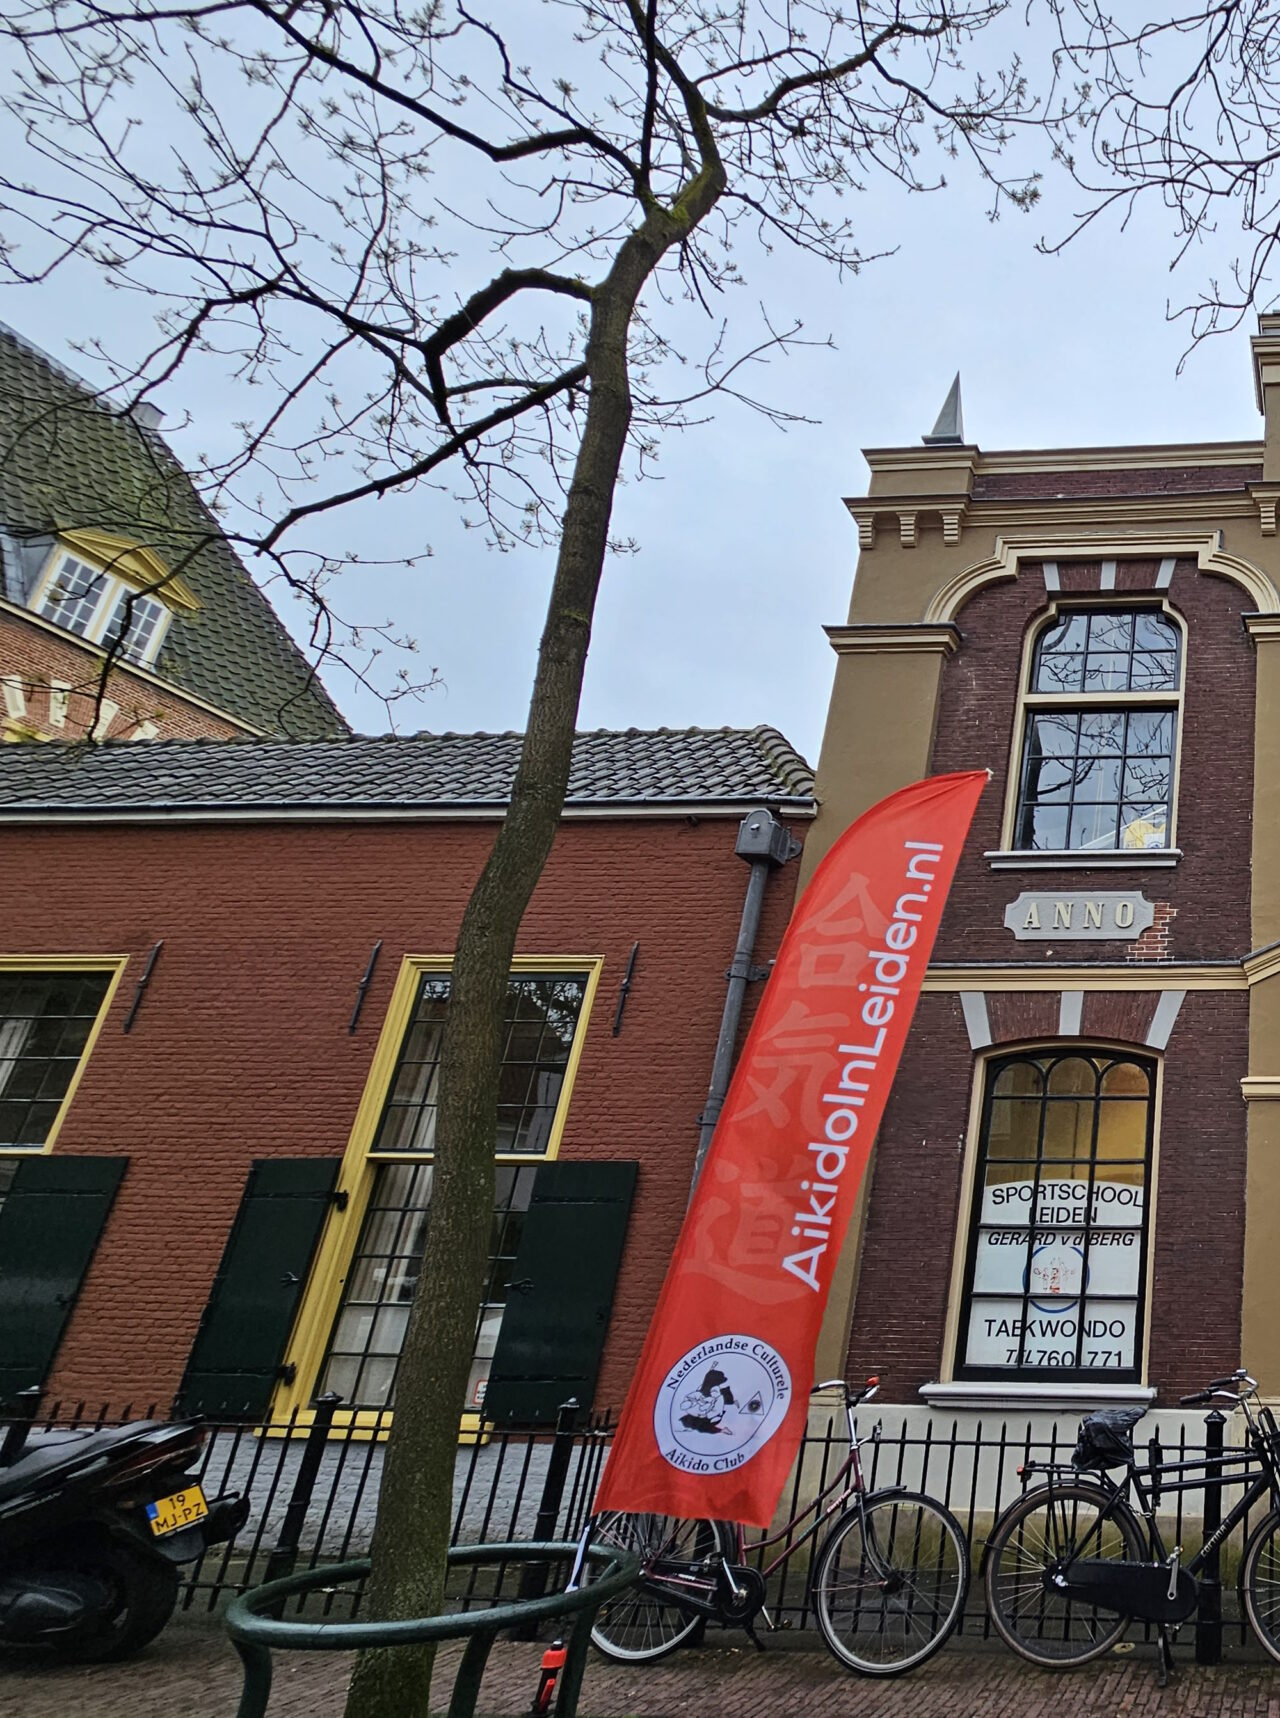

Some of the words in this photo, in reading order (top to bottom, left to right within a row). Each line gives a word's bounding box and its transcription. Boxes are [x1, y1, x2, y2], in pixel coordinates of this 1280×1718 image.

[1022, 901, 1135, 930] ANNO
[781, 840, 944, 1293] AikidoInLeiden.nl
[992, 1184, 1143, 1208] SPORTSCHOOL
[988, 1232, 1056, 1246] GERARD
[1088, 1232, 1135, 1246] BERG
[984, 1319, 1126, 1338] TAEKWONDO
[666, 1338, 749, 1391] Nederlandse
[752, 1343, 789, 1400] Culturele
[1036, 1350, 1075, 1367] 760
[1087, 1350, 1122, 1367] 771
[665, 1448, 709, 1472] Aikido
[713, 1453, 745, 1471] Club
[169, 1494, 186, 1509] 19
[155, 1502, 204, 1532] MJ-PZ
